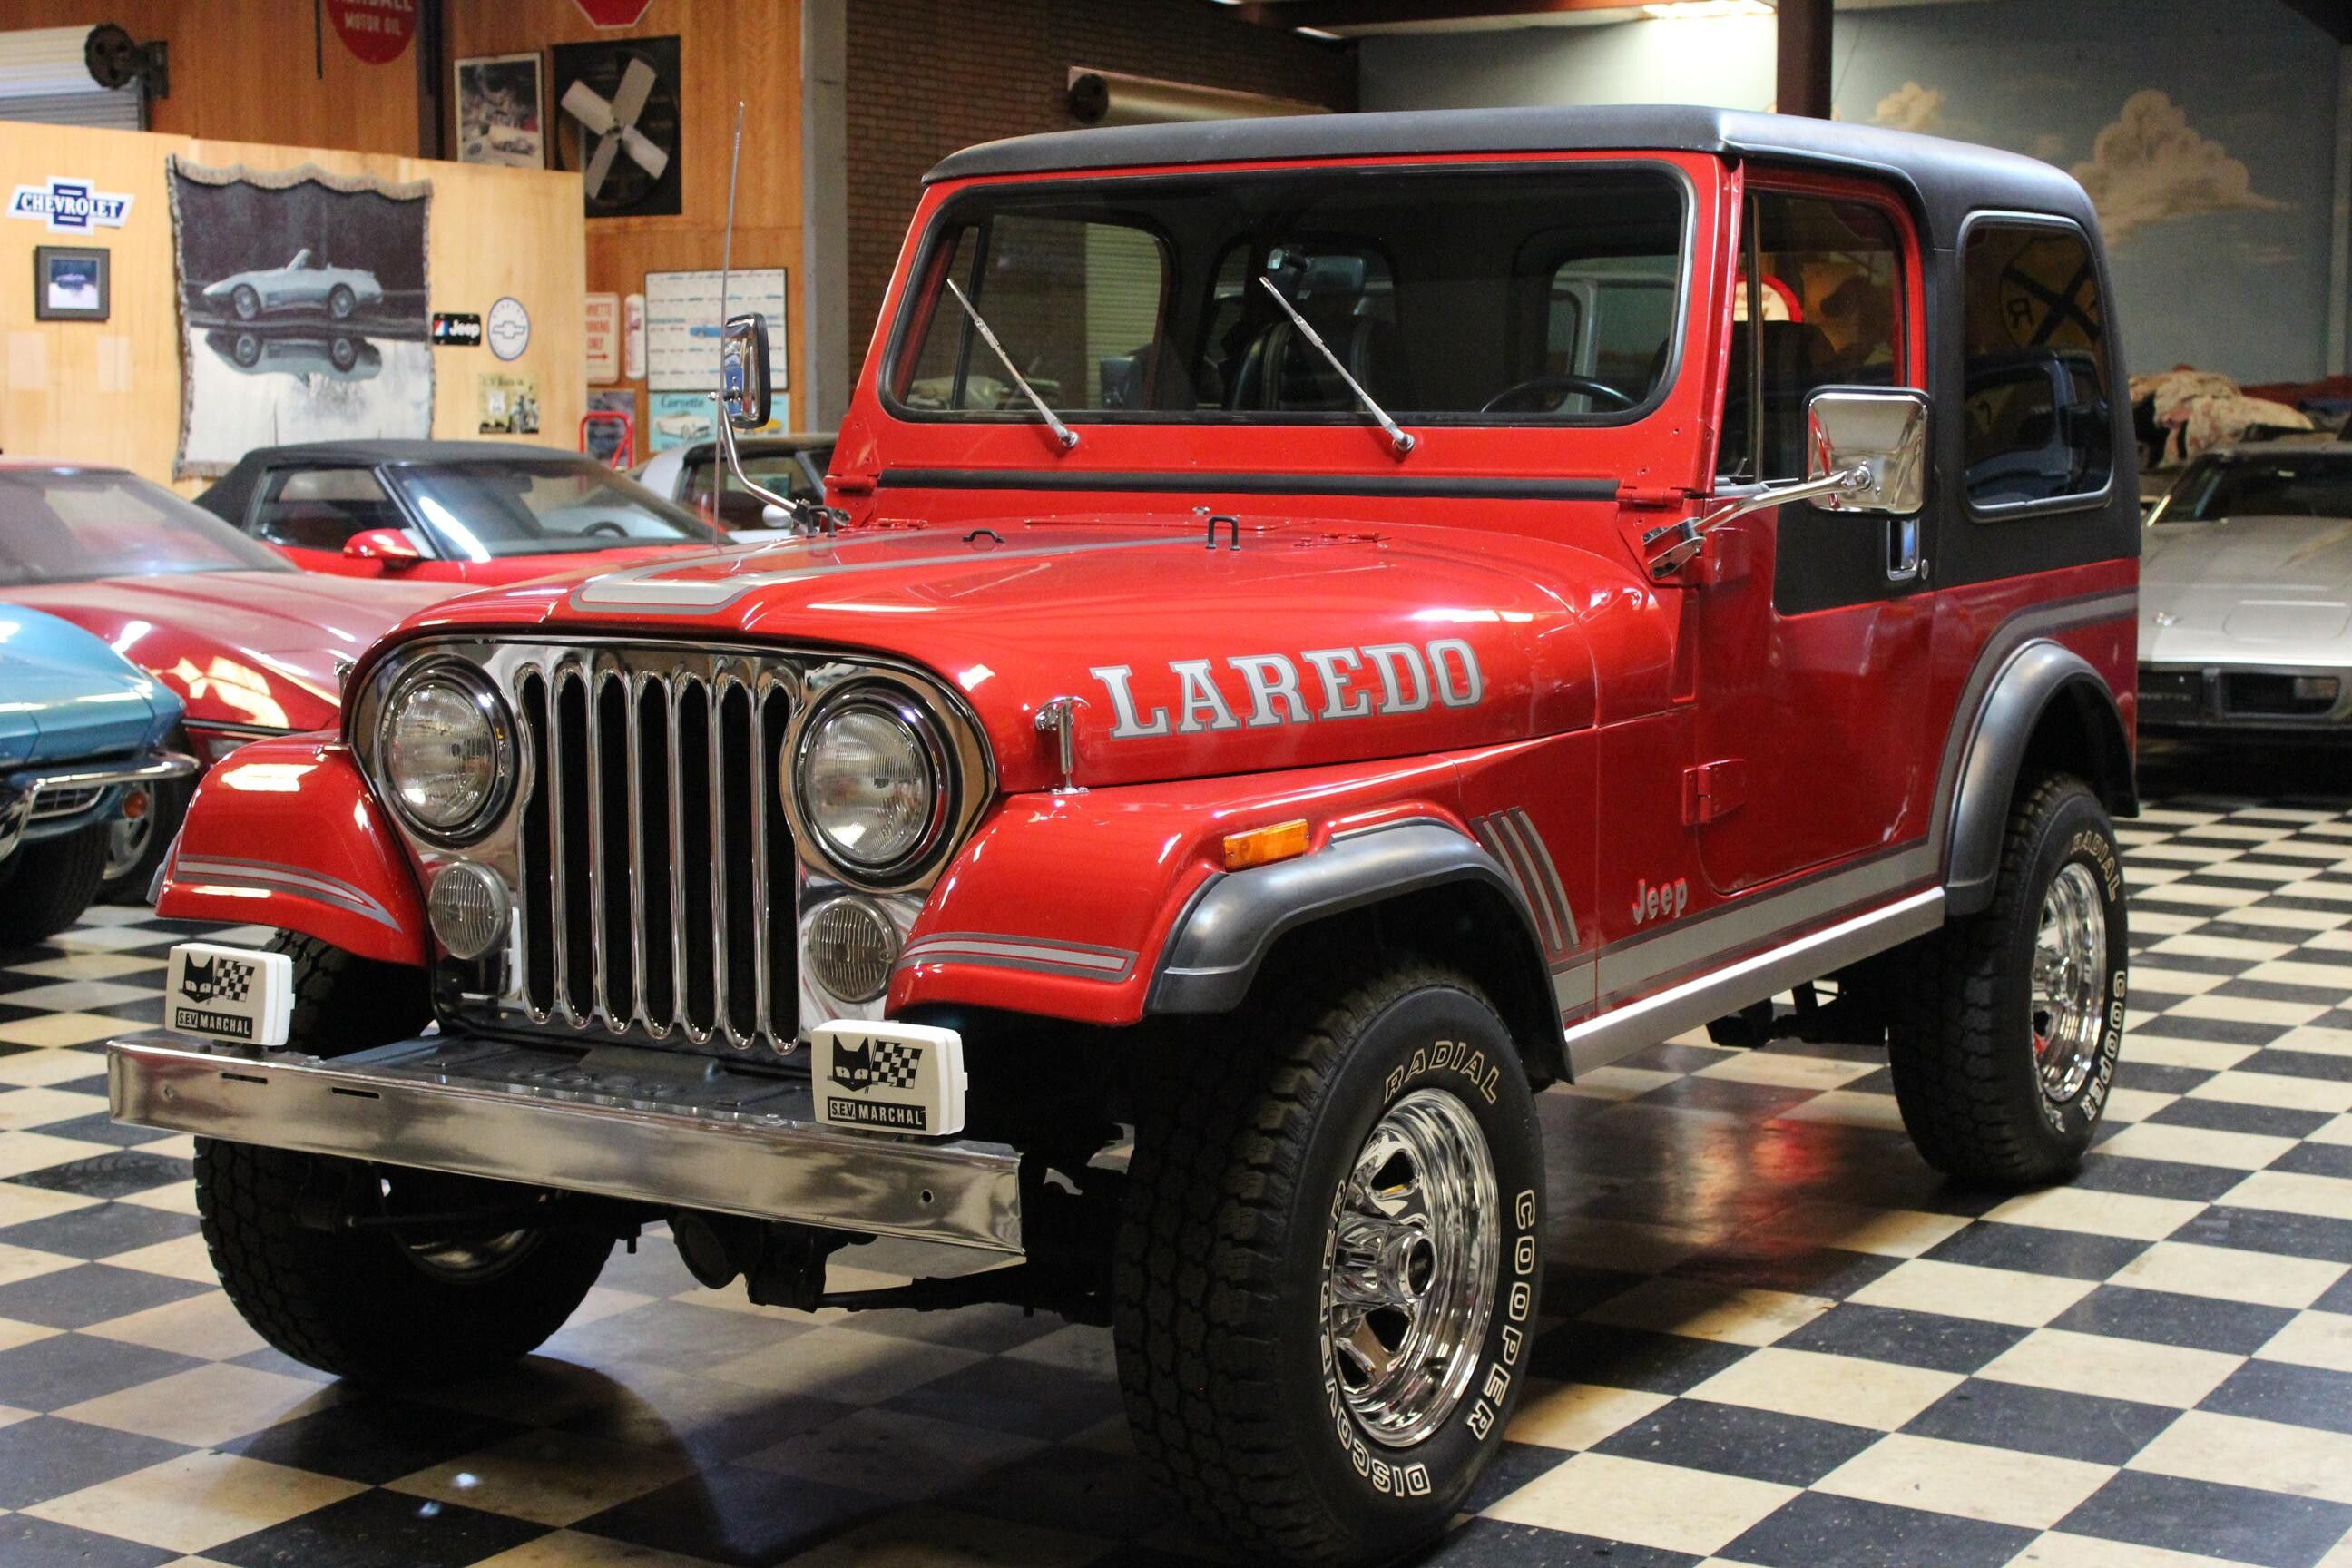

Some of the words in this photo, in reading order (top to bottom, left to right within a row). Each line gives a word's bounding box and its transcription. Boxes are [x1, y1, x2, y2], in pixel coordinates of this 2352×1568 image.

[345, 12, 380, 32] MOTOR
[384, 17, 403, 35] OIL
[20, 192, 120, 219] CHEVROLET
[448, 318, 481, 338] Jeep
[1089, 638, 1485, 740] LAREDO
[2070, 830, 2121, 903] RADIAL
[1632, 877, 1688, 926] Jeep
[200, 1014, 250, 1034] MARCHAL
[2080, 969, 2127, 1122] COOPER
[1384, 1040, 1500, 1105] RADIAL
[858, 1103, 923, 1126] MARCHAL
[1319, 1179, 1432, 1498] DISCOVERER
[1465, 1189, 1536, 1441] COOPER
